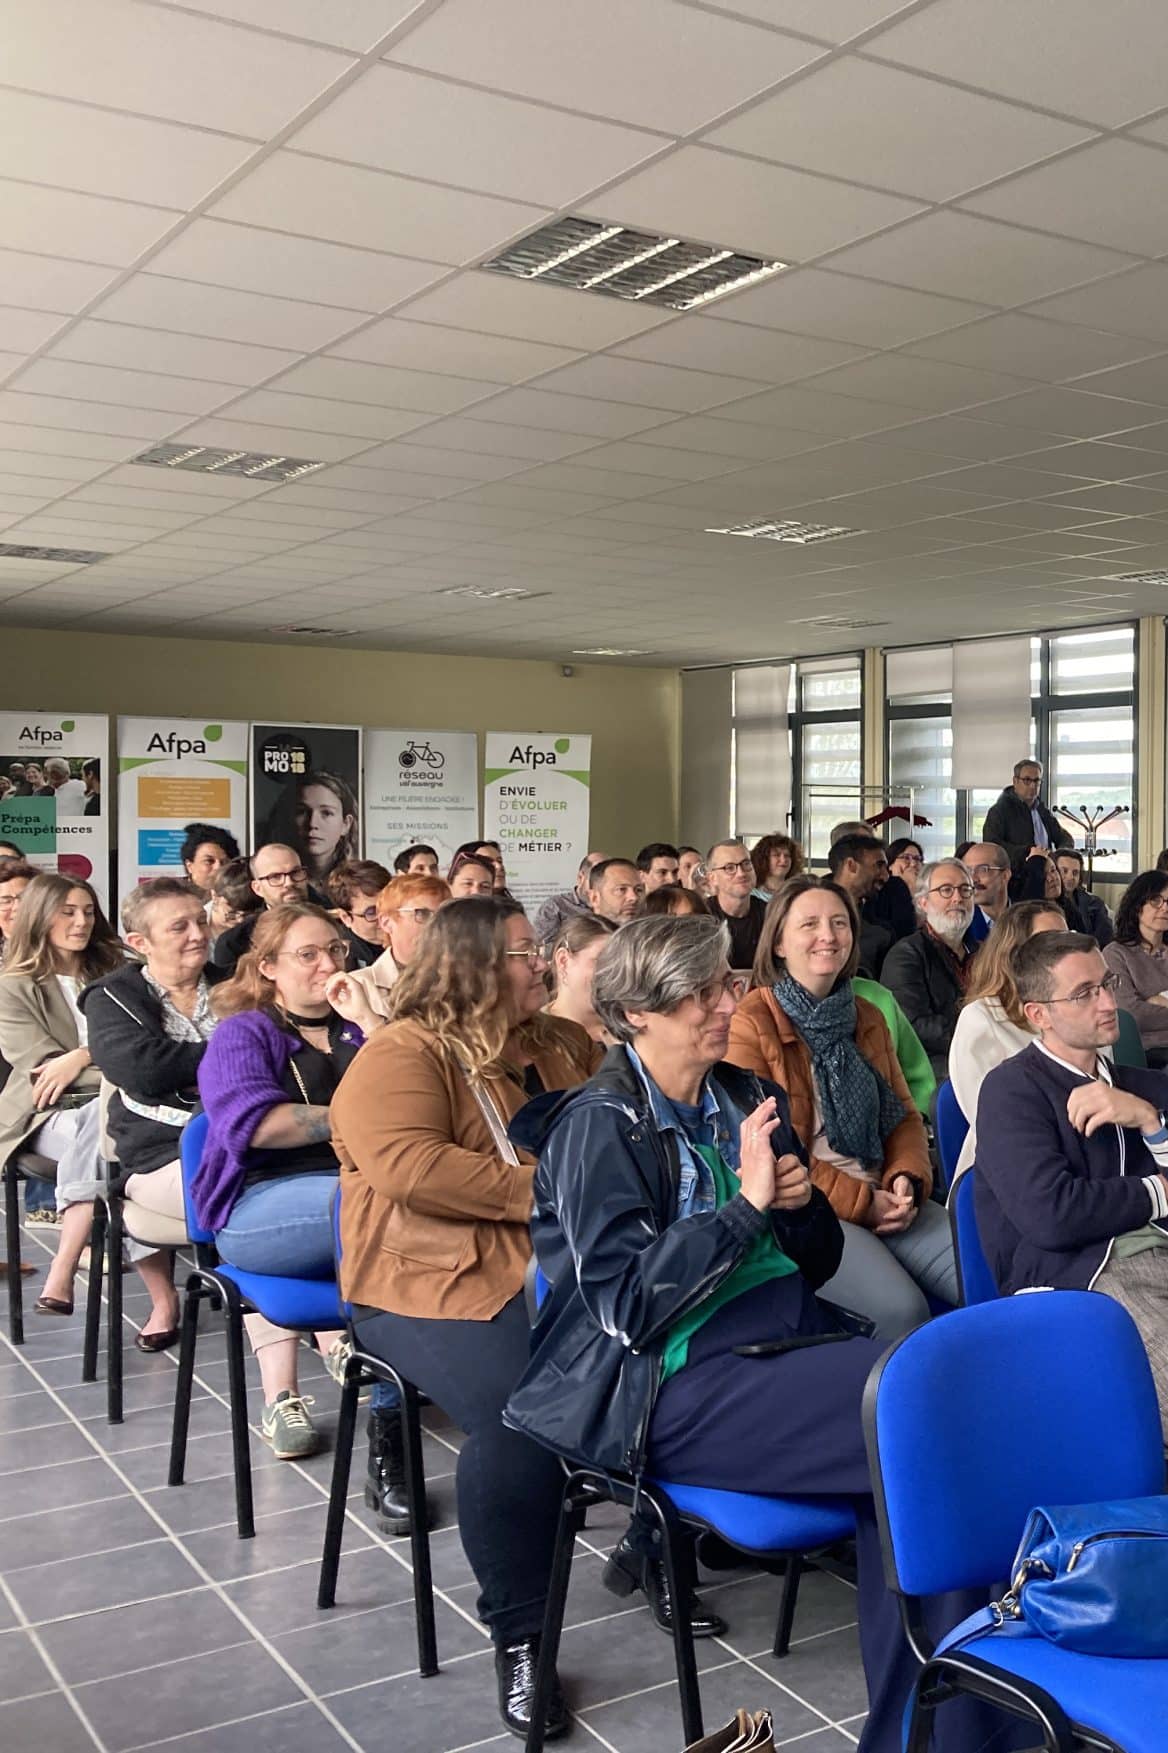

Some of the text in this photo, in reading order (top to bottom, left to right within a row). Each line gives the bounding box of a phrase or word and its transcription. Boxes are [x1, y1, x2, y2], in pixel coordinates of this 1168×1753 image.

[18, 726, 63, 745] Afpa
[146, 732, 206, 760] Afpa
[264, 751, 289, 761] PRO
[508, 745, 556, 770] Afpa
[264, 760, 289, 772] MO
[399, 769, 444, 780] réseau
[499, 786, 536, 796] ENVIE
[1, 812, 41, 826] Prépa
[499, 814, 537, 824] OU DE
[1, 824, 93, 836] Compétences
[406, 822, 449, 830] MISSIONS
[499, 829, 558, 838] CHANGER
[518, 841, 562, 852] MÉTIER
